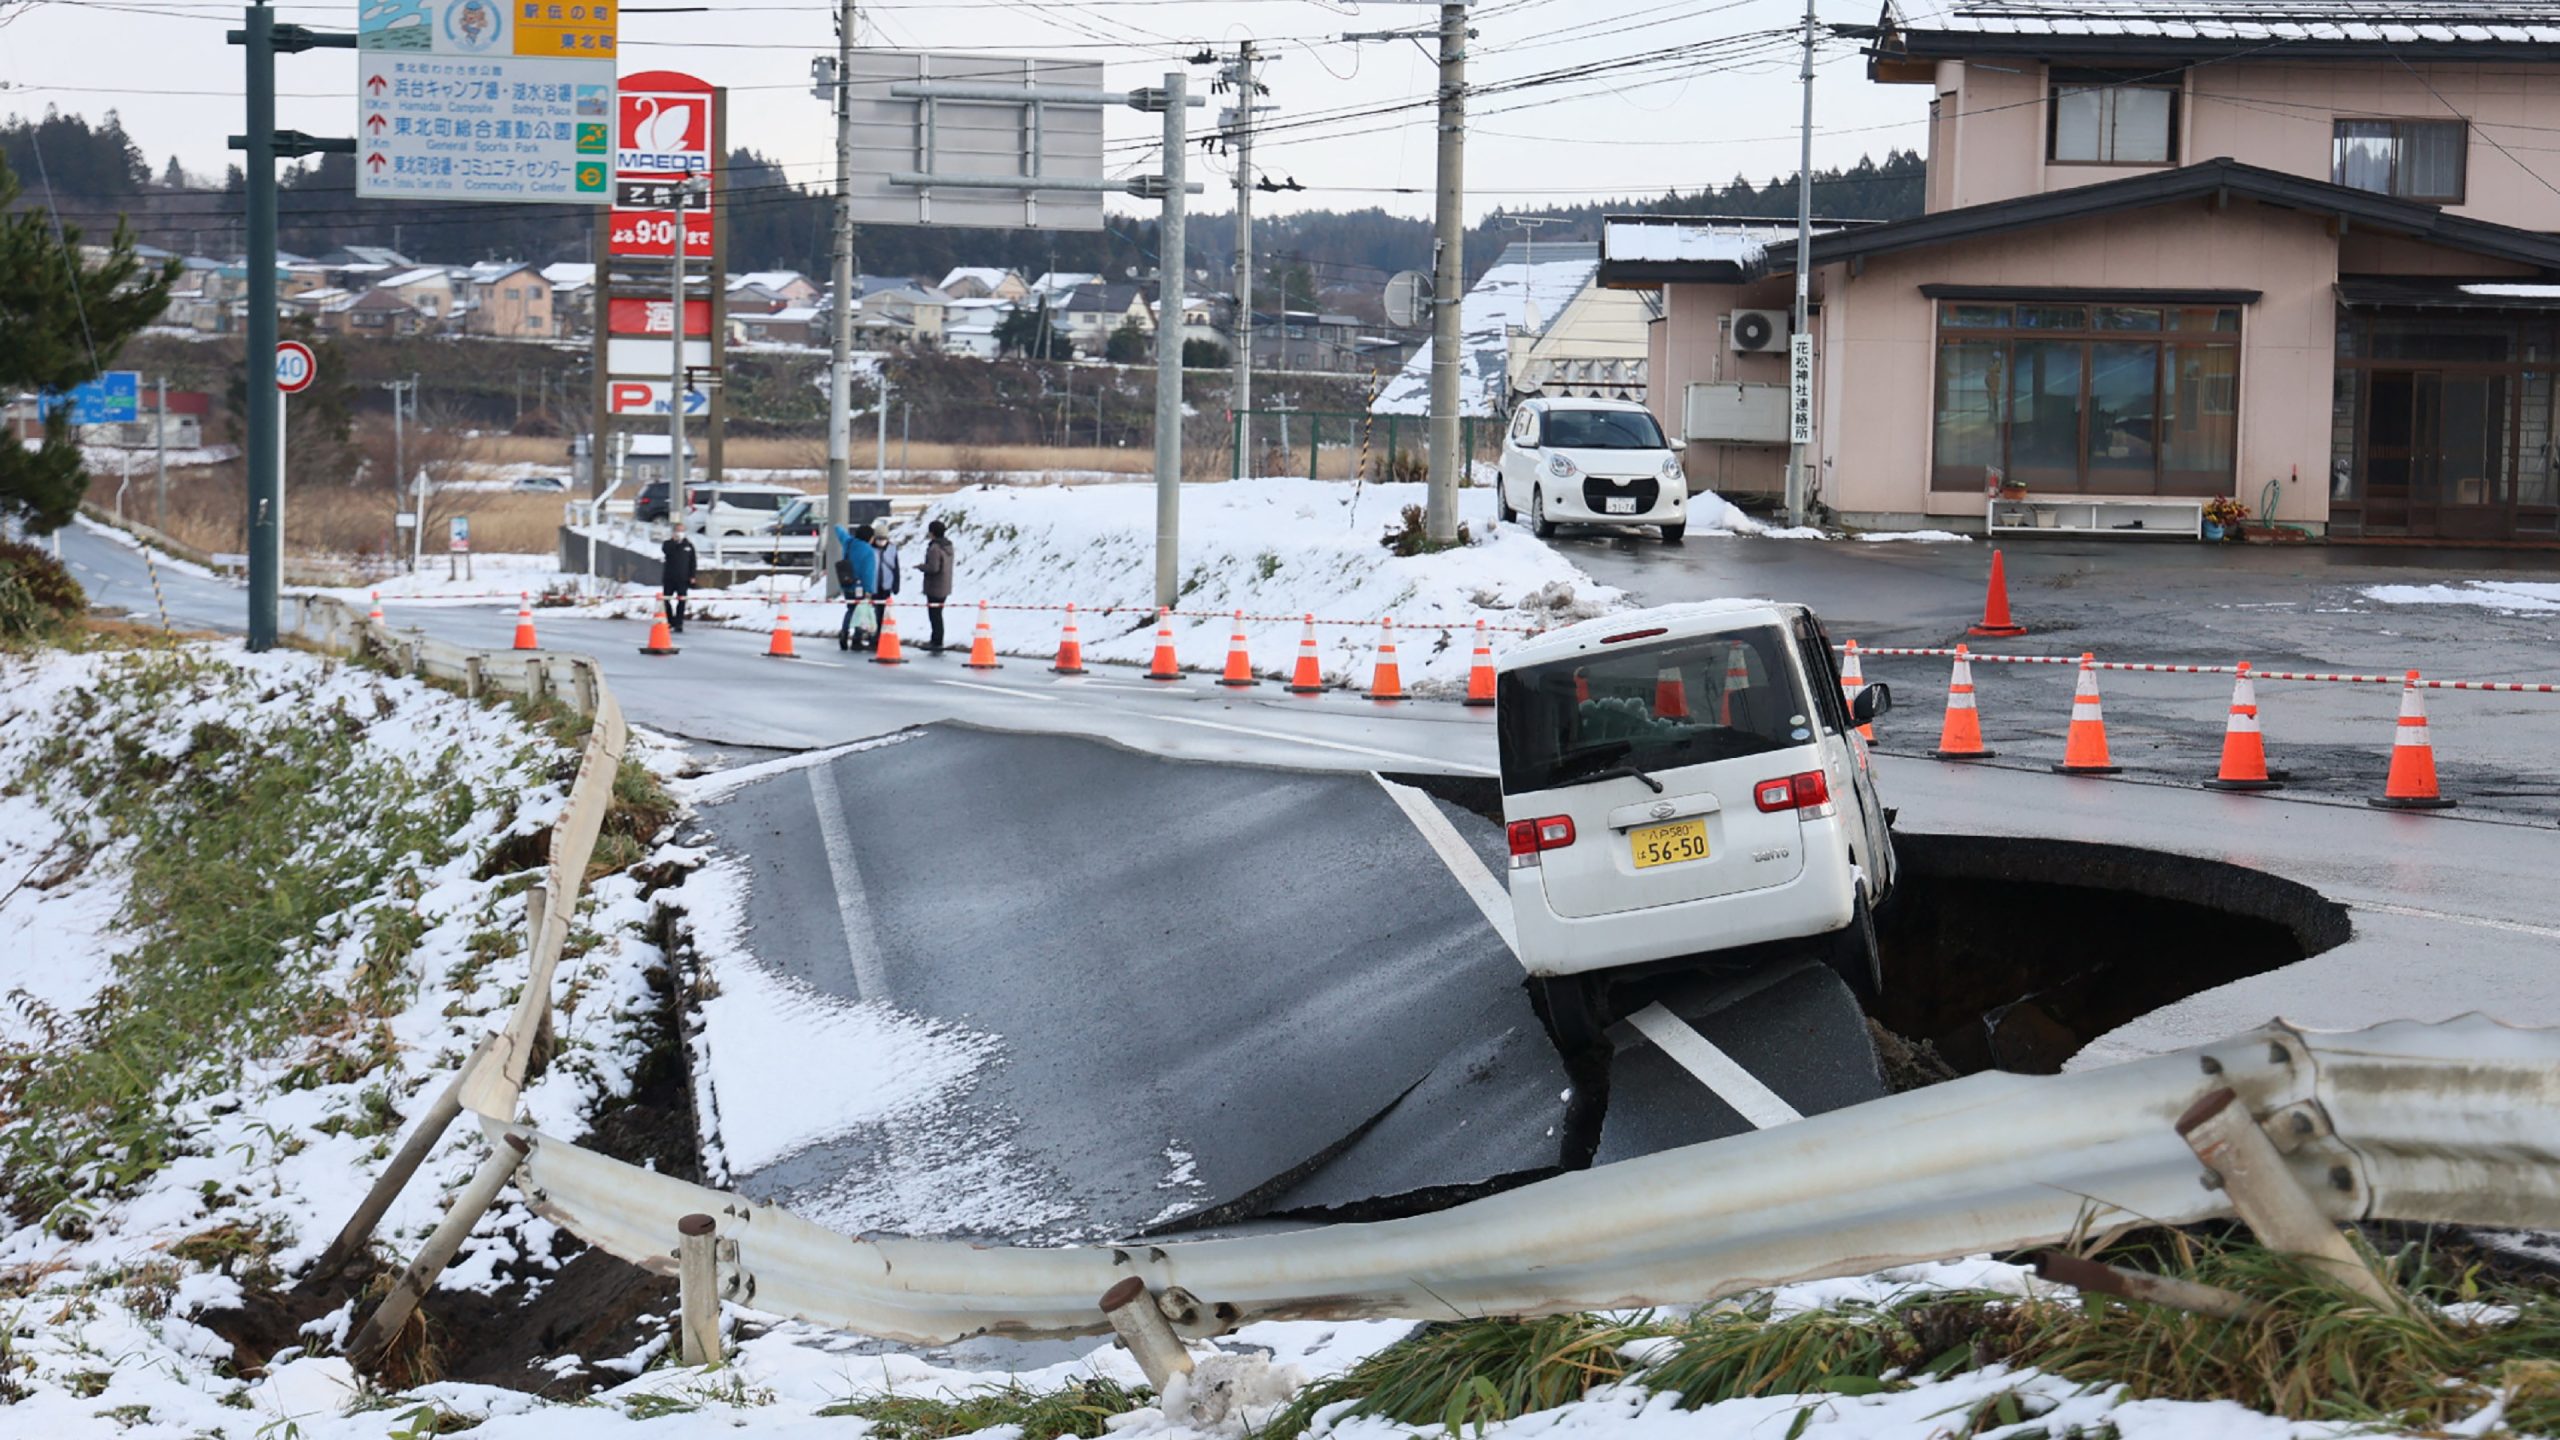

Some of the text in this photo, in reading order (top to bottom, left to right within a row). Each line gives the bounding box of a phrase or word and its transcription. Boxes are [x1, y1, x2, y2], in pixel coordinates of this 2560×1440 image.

[524, 3, 608, 21] 駅伝の町
[561, 33, 614, 49] 東北町
[394, 117, 572, 141] 東北町総合運動公園
[426, 139, 468, 151] General
[474, 140, 509, 153] Sports
[515, 142, 539, 153] Park
[618, 153, 705, 170] MAEDA
[464, 179, 523, 192] Community
[530, 181, 567, 192] Center
[275, 356, 303, 378] 40
[612, 383, 653, 413] P
[1795, 341, 1809, 439] 花松神社連絡所
[1648, 835, 1705, 863] 56-50
